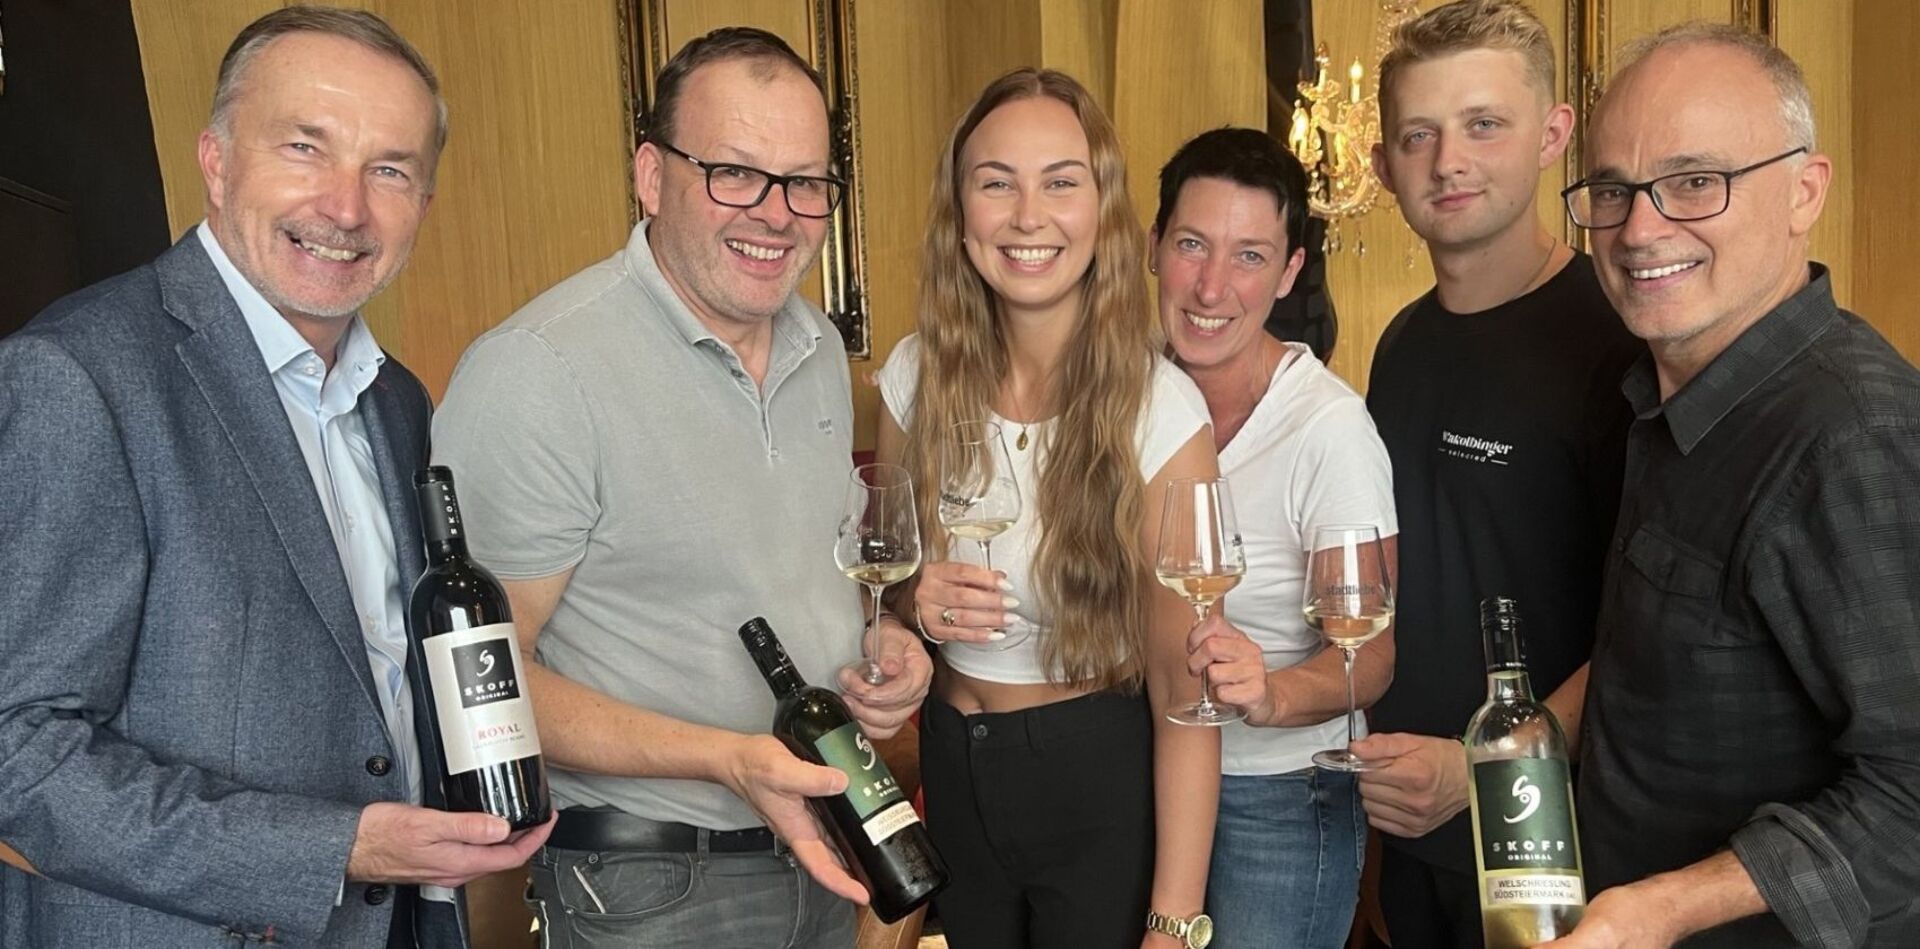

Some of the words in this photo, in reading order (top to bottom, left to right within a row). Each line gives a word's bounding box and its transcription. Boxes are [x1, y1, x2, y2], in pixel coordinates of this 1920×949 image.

[464, 679, 514, 697] SKOFF
[477, 722, 522, 741] ROYAL
[1493, 840, 1565, 852] SKOFF
